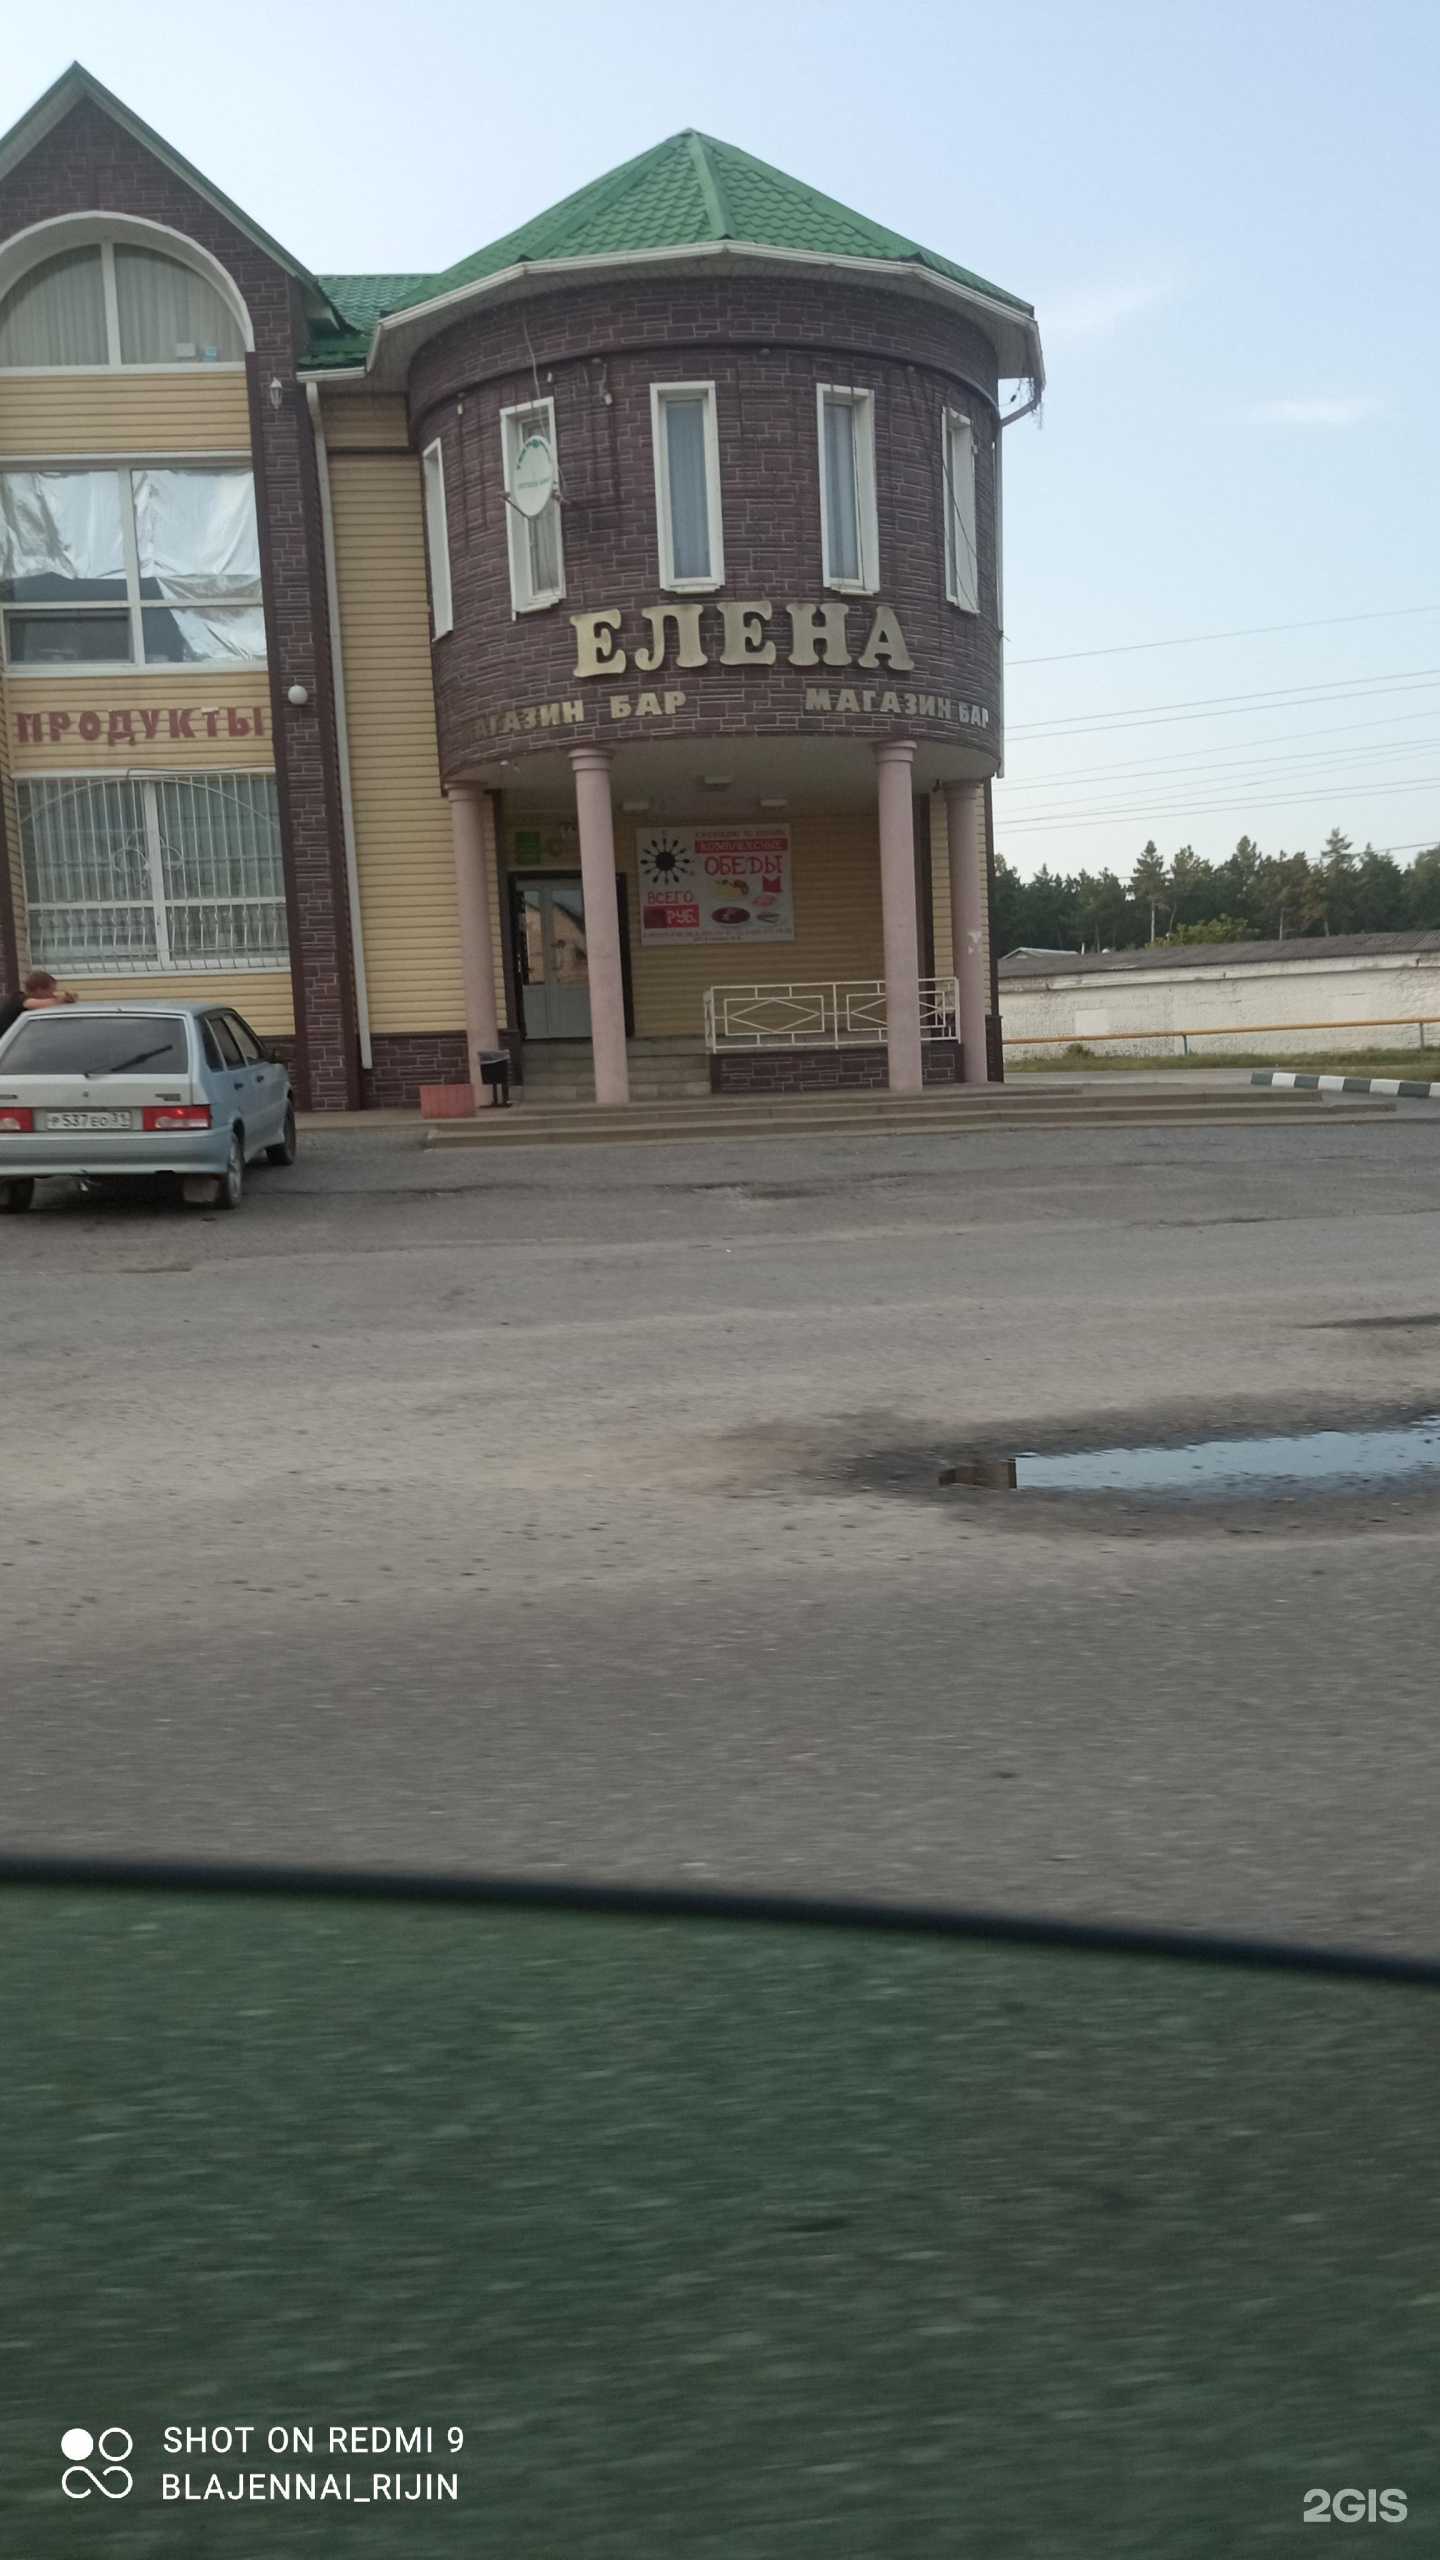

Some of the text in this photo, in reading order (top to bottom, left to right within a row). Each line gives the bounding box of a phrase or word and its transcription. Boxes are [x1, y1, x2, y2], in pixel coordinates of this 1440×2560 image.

[570, 599, 914, 678] ЕЛЕНА
[16, 706, 265, 746] ПРОДУКТЫ
[463, 689, 687, 739] АГАЗИН БАР
[805, 687, 990, 729] МАГАЗИН БАР
[704, 855, 783, 876] ОБЕДЫ
[647, 889, 695, 904] ВСЕГО
